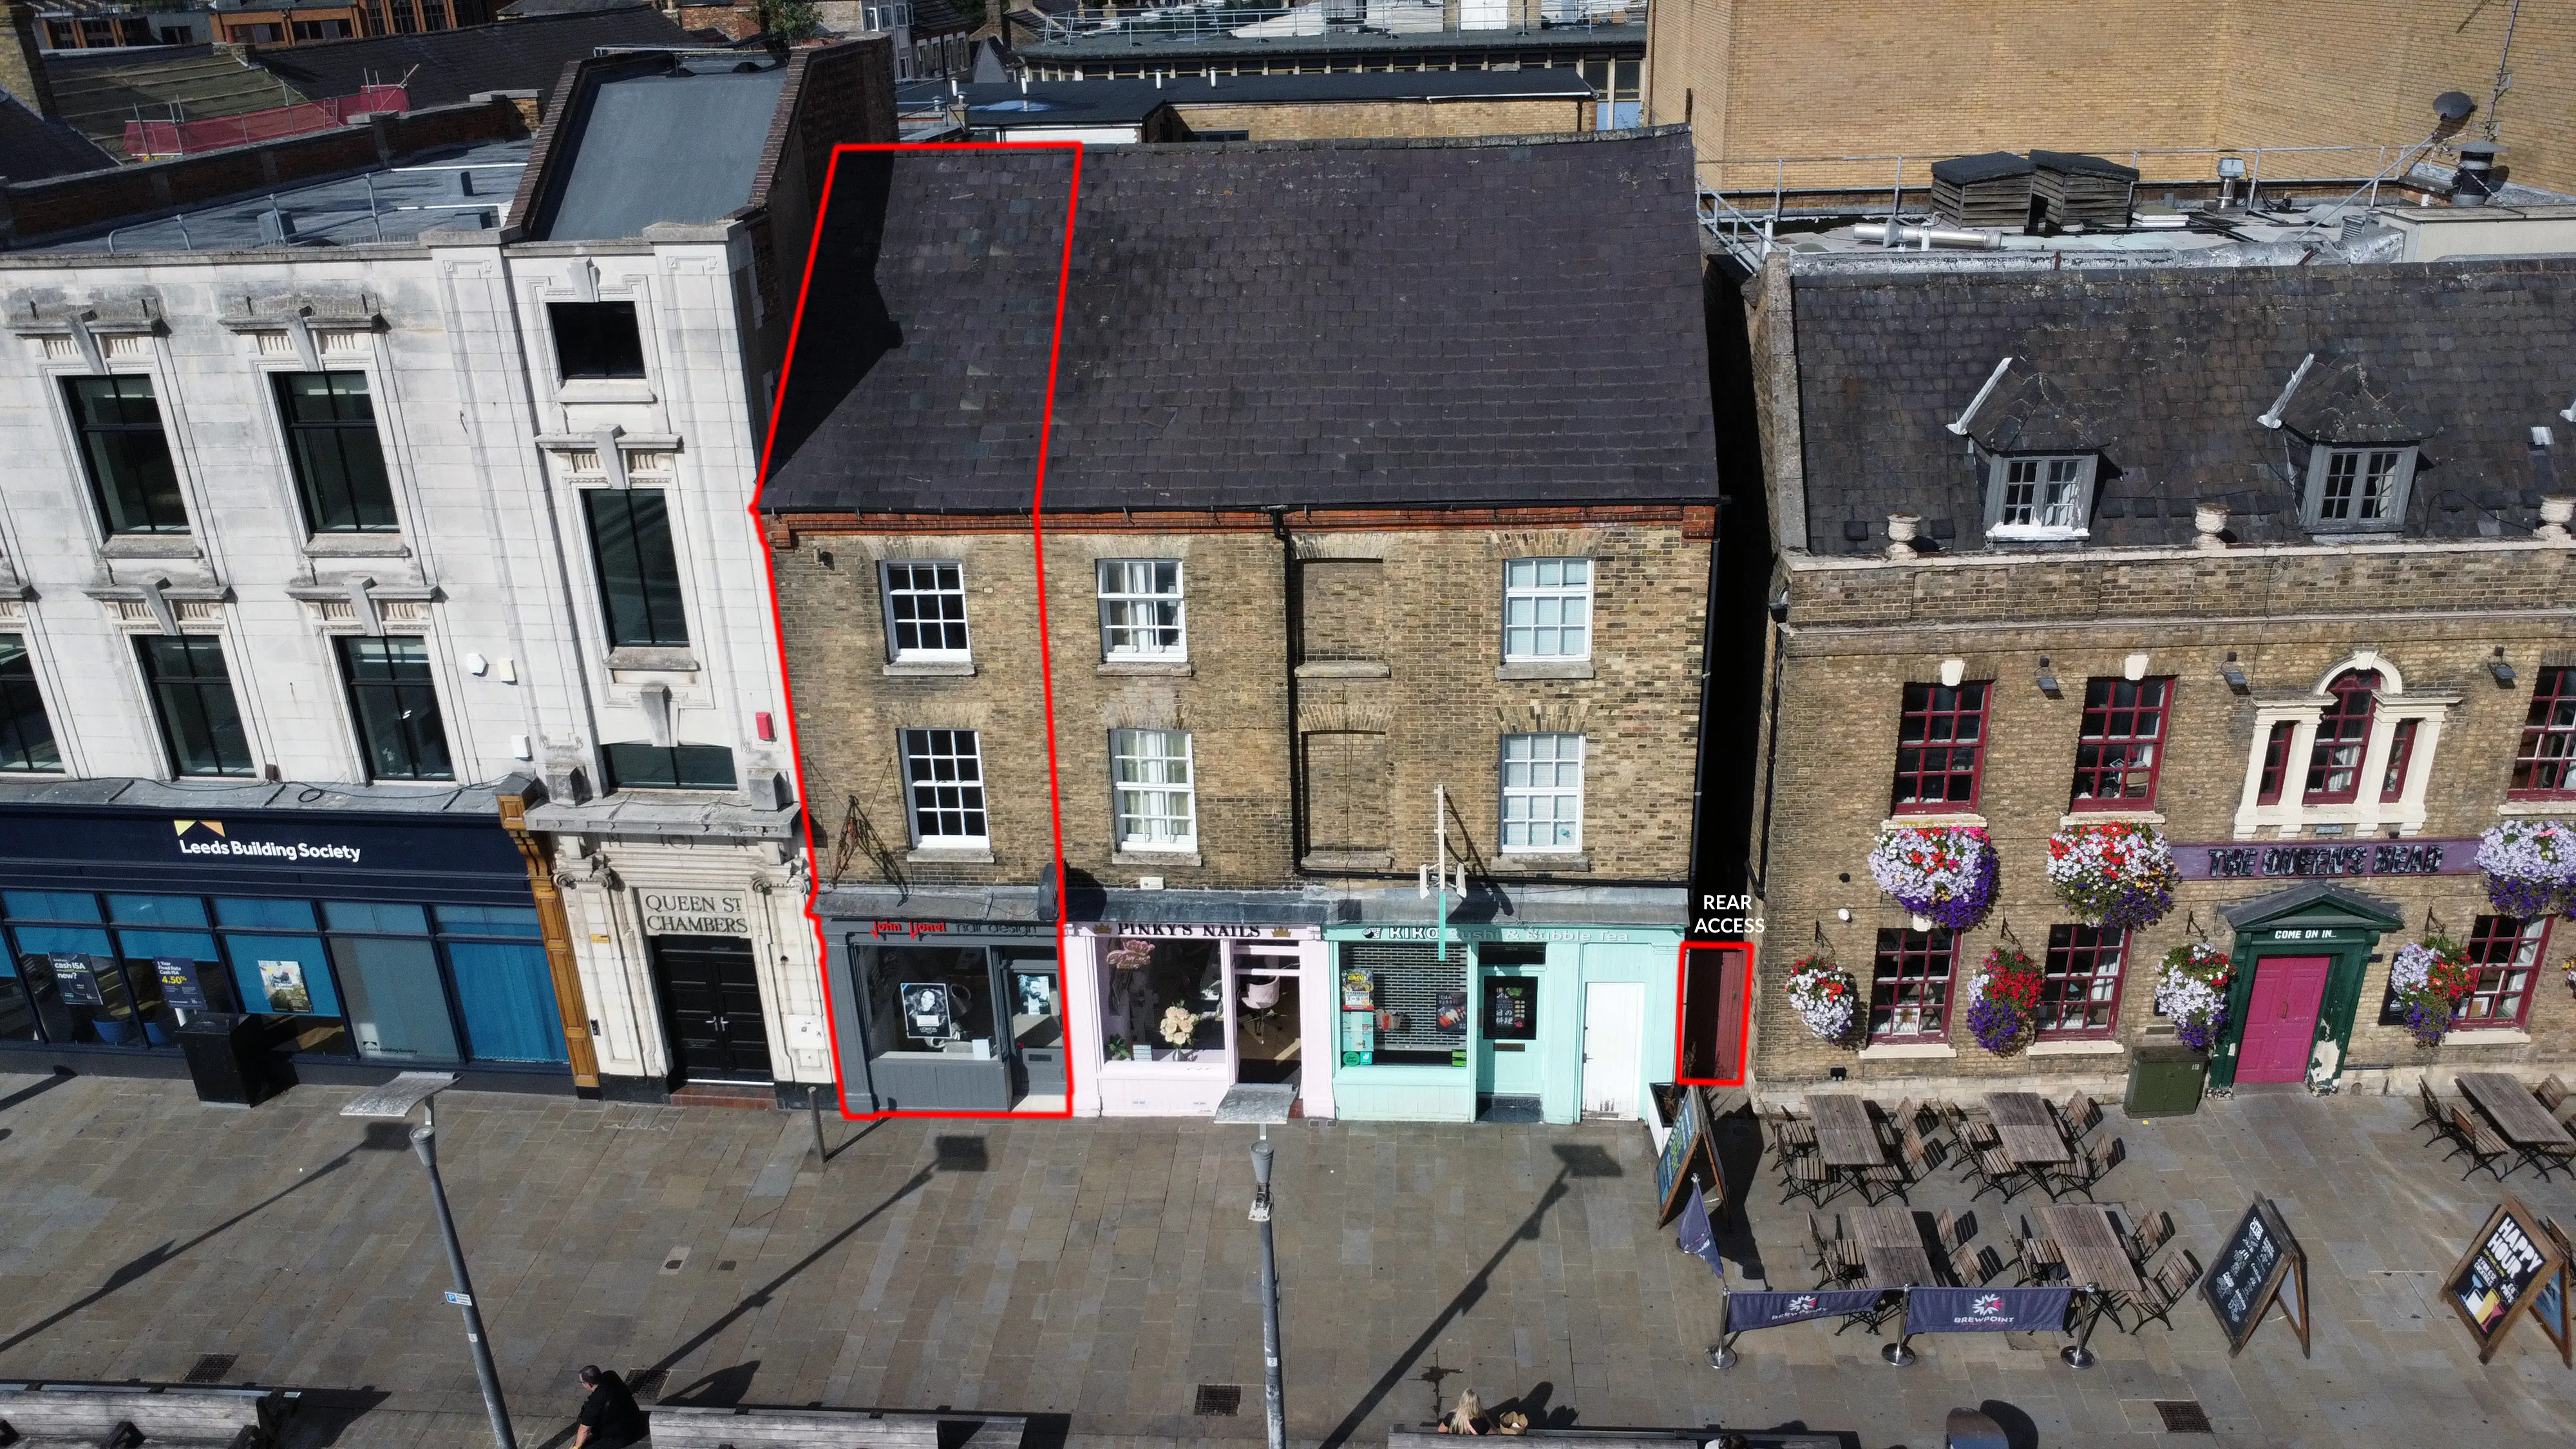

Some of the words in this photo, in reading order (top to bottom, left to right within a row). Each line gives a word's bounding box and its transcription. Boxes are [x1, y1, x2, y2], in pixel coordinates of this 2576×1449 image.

[180, 840, 230, 855] Leeds
[231, 840, 298, 860] Building
[298, 843, 361, 862] Society
[2209, 848, 2257, 877] THE
[2262, 846, 2368, 876] QUEEN'S
[2373, 844, 2445, 874] HEAD
[645, 895, 715, 912] QUEEN
[647, 915, 748, 933] CHAMBERS
[868, 920, 902, 940] John
[1118, 923, 1193, 936] PINKY'S
[1203, 924, 1260, 937] NAILS
[1388, 926, 1440, 940] KIKO
[1506, 930, 1520, 941] &
[1526, 929, 1592, 942] Bubble
[1598, 931, 1629, 942] Tea
[2275, 931, 2302, 939] COME
[2305, 930, 2318, 938] ON
[2250, 1220, 2261, 1240] CLUB
[2498, 1217, 2543, 1272] HAPPY
[2487, 1233, 2521, 1278] HOUR
